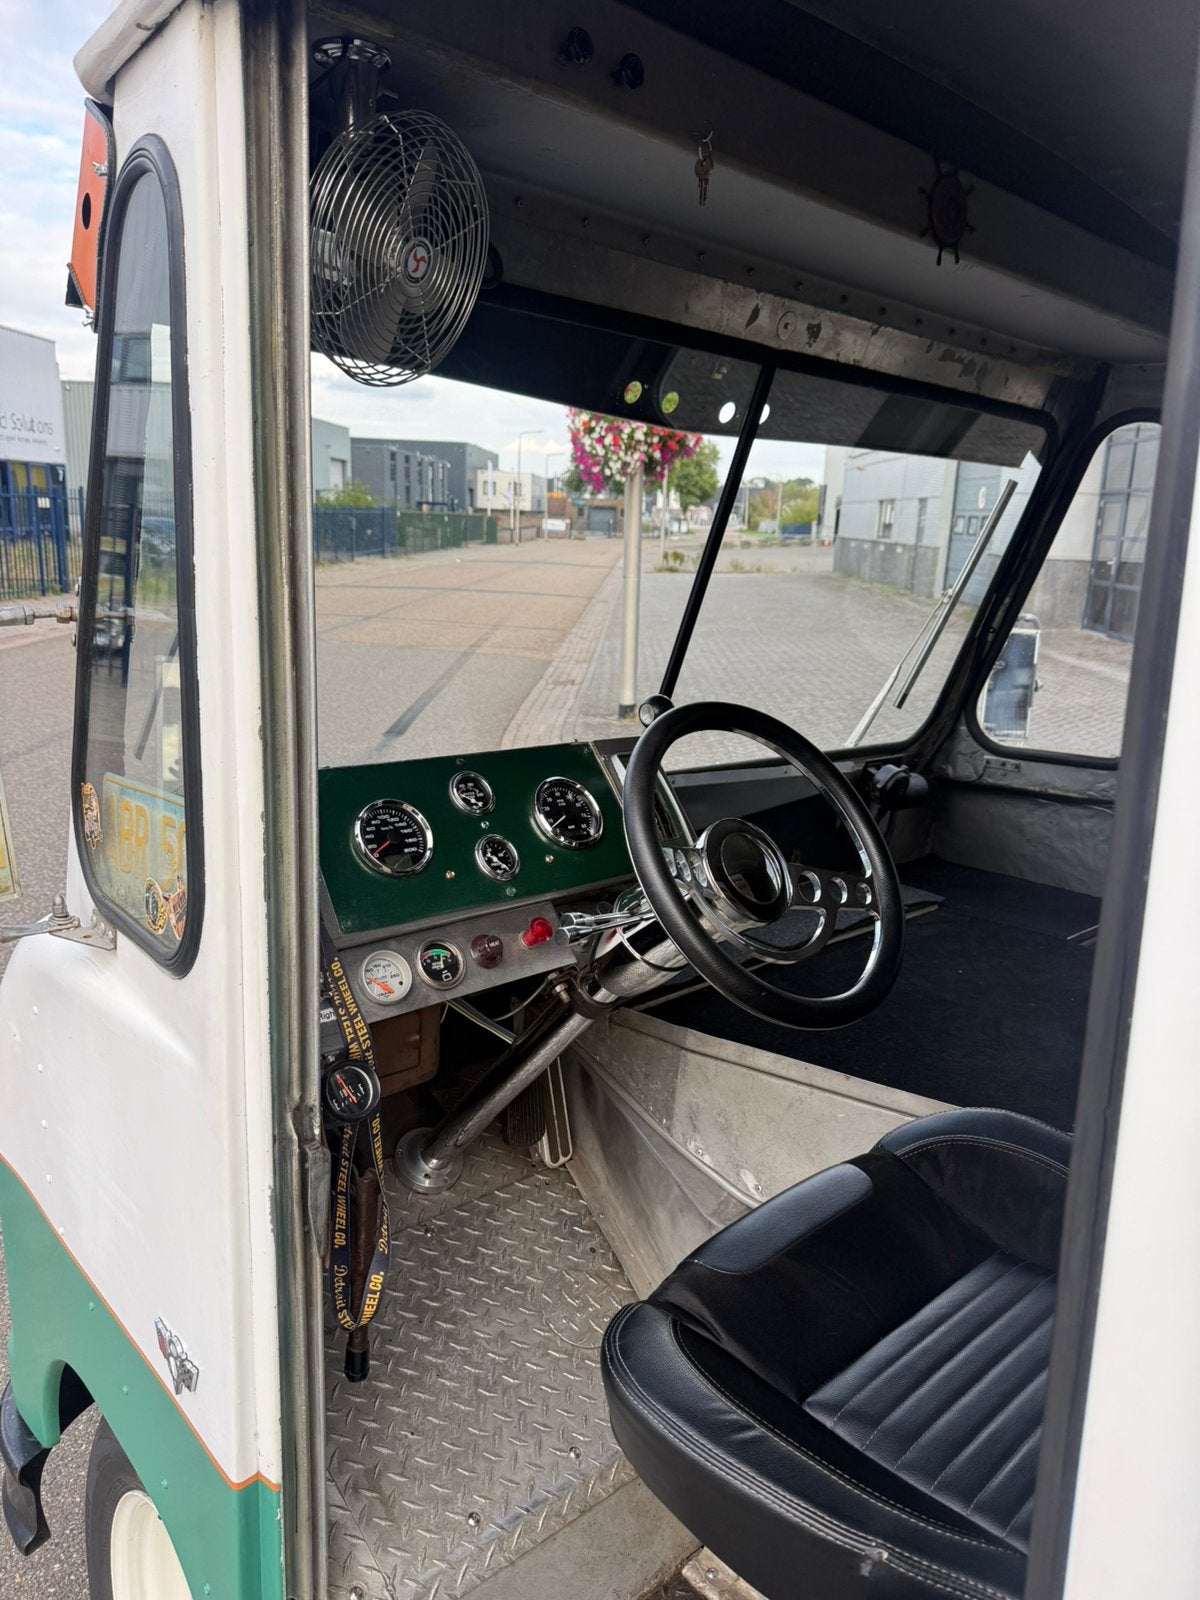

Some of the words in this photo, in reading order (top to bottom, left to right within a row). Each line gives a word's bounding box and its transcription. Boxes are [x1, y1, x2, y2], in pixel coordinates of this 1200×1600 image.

[11, 412, 54, 435] Solutions
[330, 956, 344, 978] CO.
[337, 975, 358, 1016] WHEEL
[320, 1010, 336, 1021] Righ
[353, 1012, 371, 1050] STEEL
[342, 1122, 353, 1159] etroit
[337, 1158, 349, 1193] STEEL
[335, 1194, 347, 1230] WHEEL
[334, 1264, 349, 1311] Detroit
[358, 1291, 380, 1328] WHEEL
[369, 1271, 385, 1291] CO.
